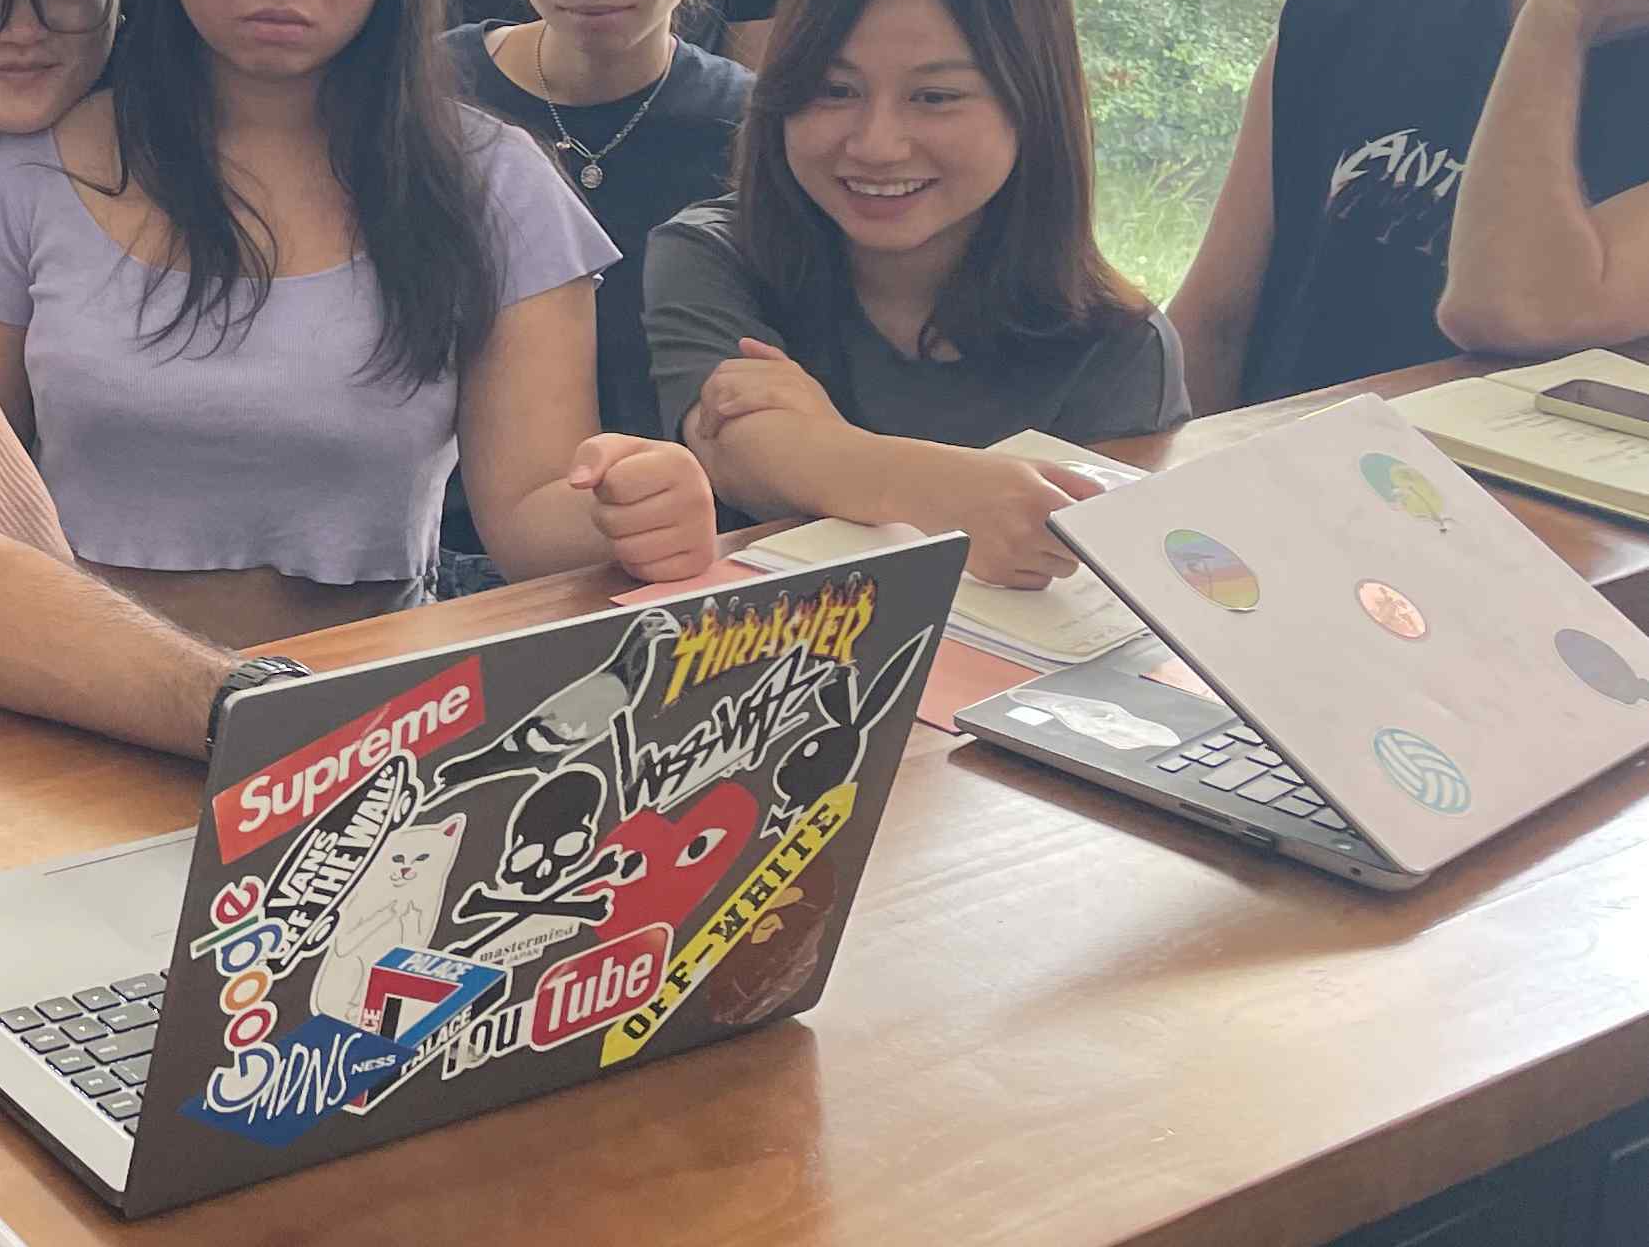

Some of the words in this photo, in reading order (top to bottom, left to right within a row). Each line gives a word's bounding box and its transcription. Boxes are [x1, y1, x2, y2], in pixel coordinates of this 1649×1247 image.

[662, 580, 877, 706] THRASHER
[238, 684, 471, 833] Supreme
[268, 828, 339, 908] VANS
[299, 848, 364, 906] THE
[193, 881, 285, 1110] Google
